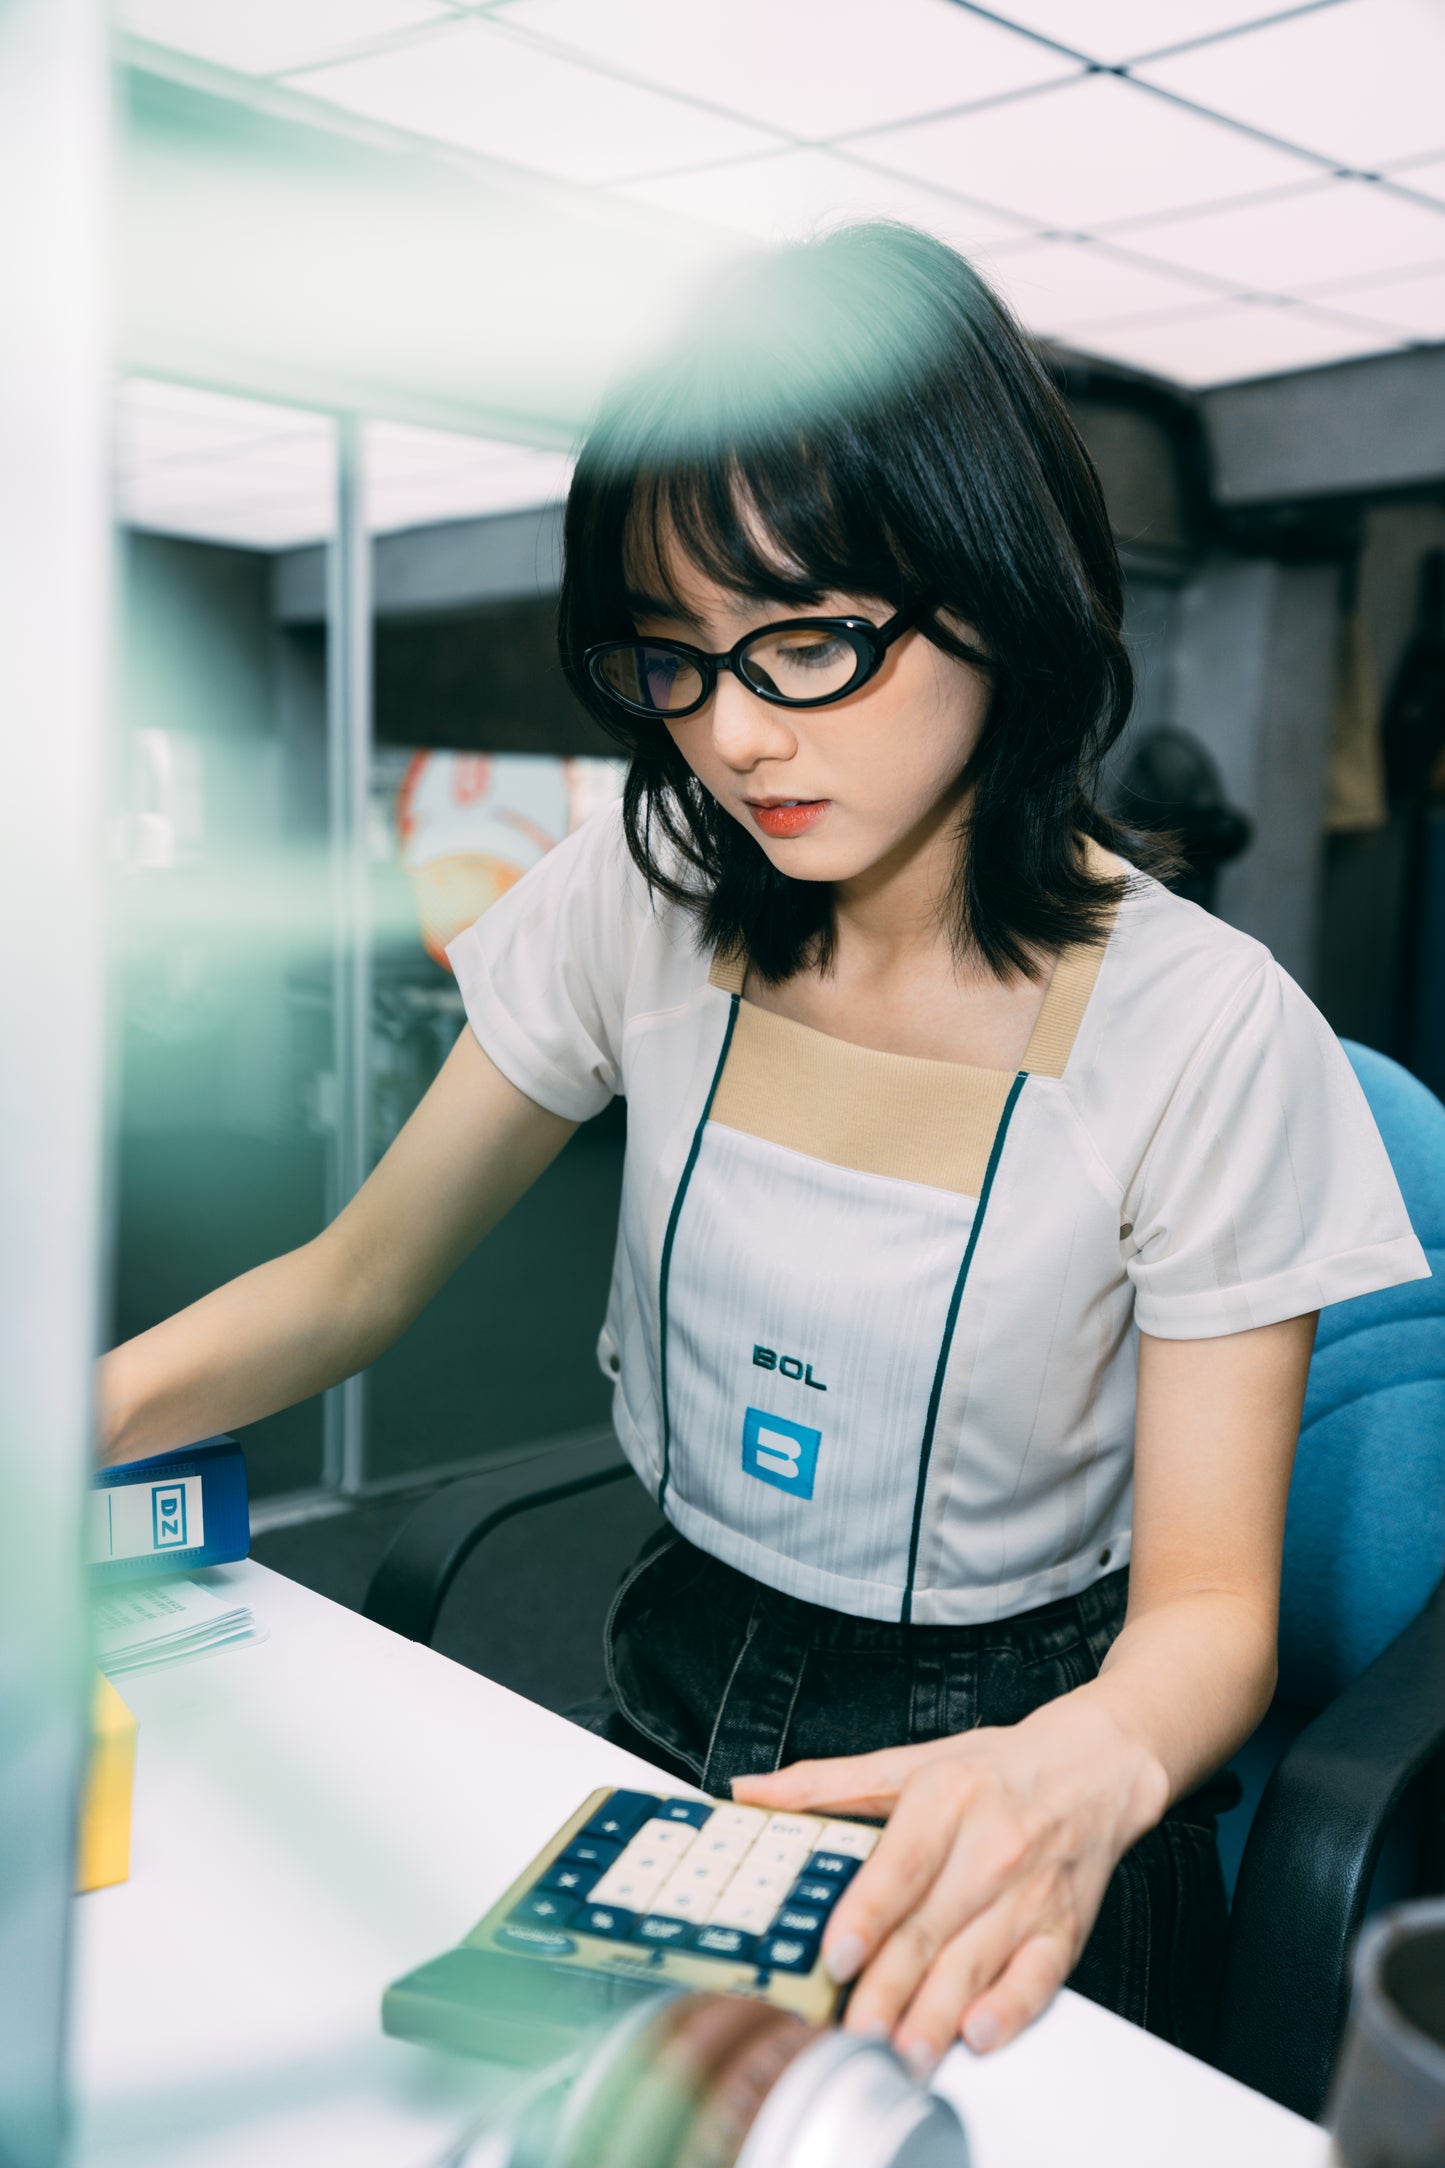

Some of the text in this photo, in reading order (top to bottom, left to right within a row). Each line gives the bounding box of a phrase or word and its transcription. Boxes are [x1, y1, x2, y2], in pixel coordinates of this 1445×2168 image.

[753, 1344, 827, 1391] BOL
[757, 1427, 801, 1478] B
[161, 1498, 178, 1537] DZ
